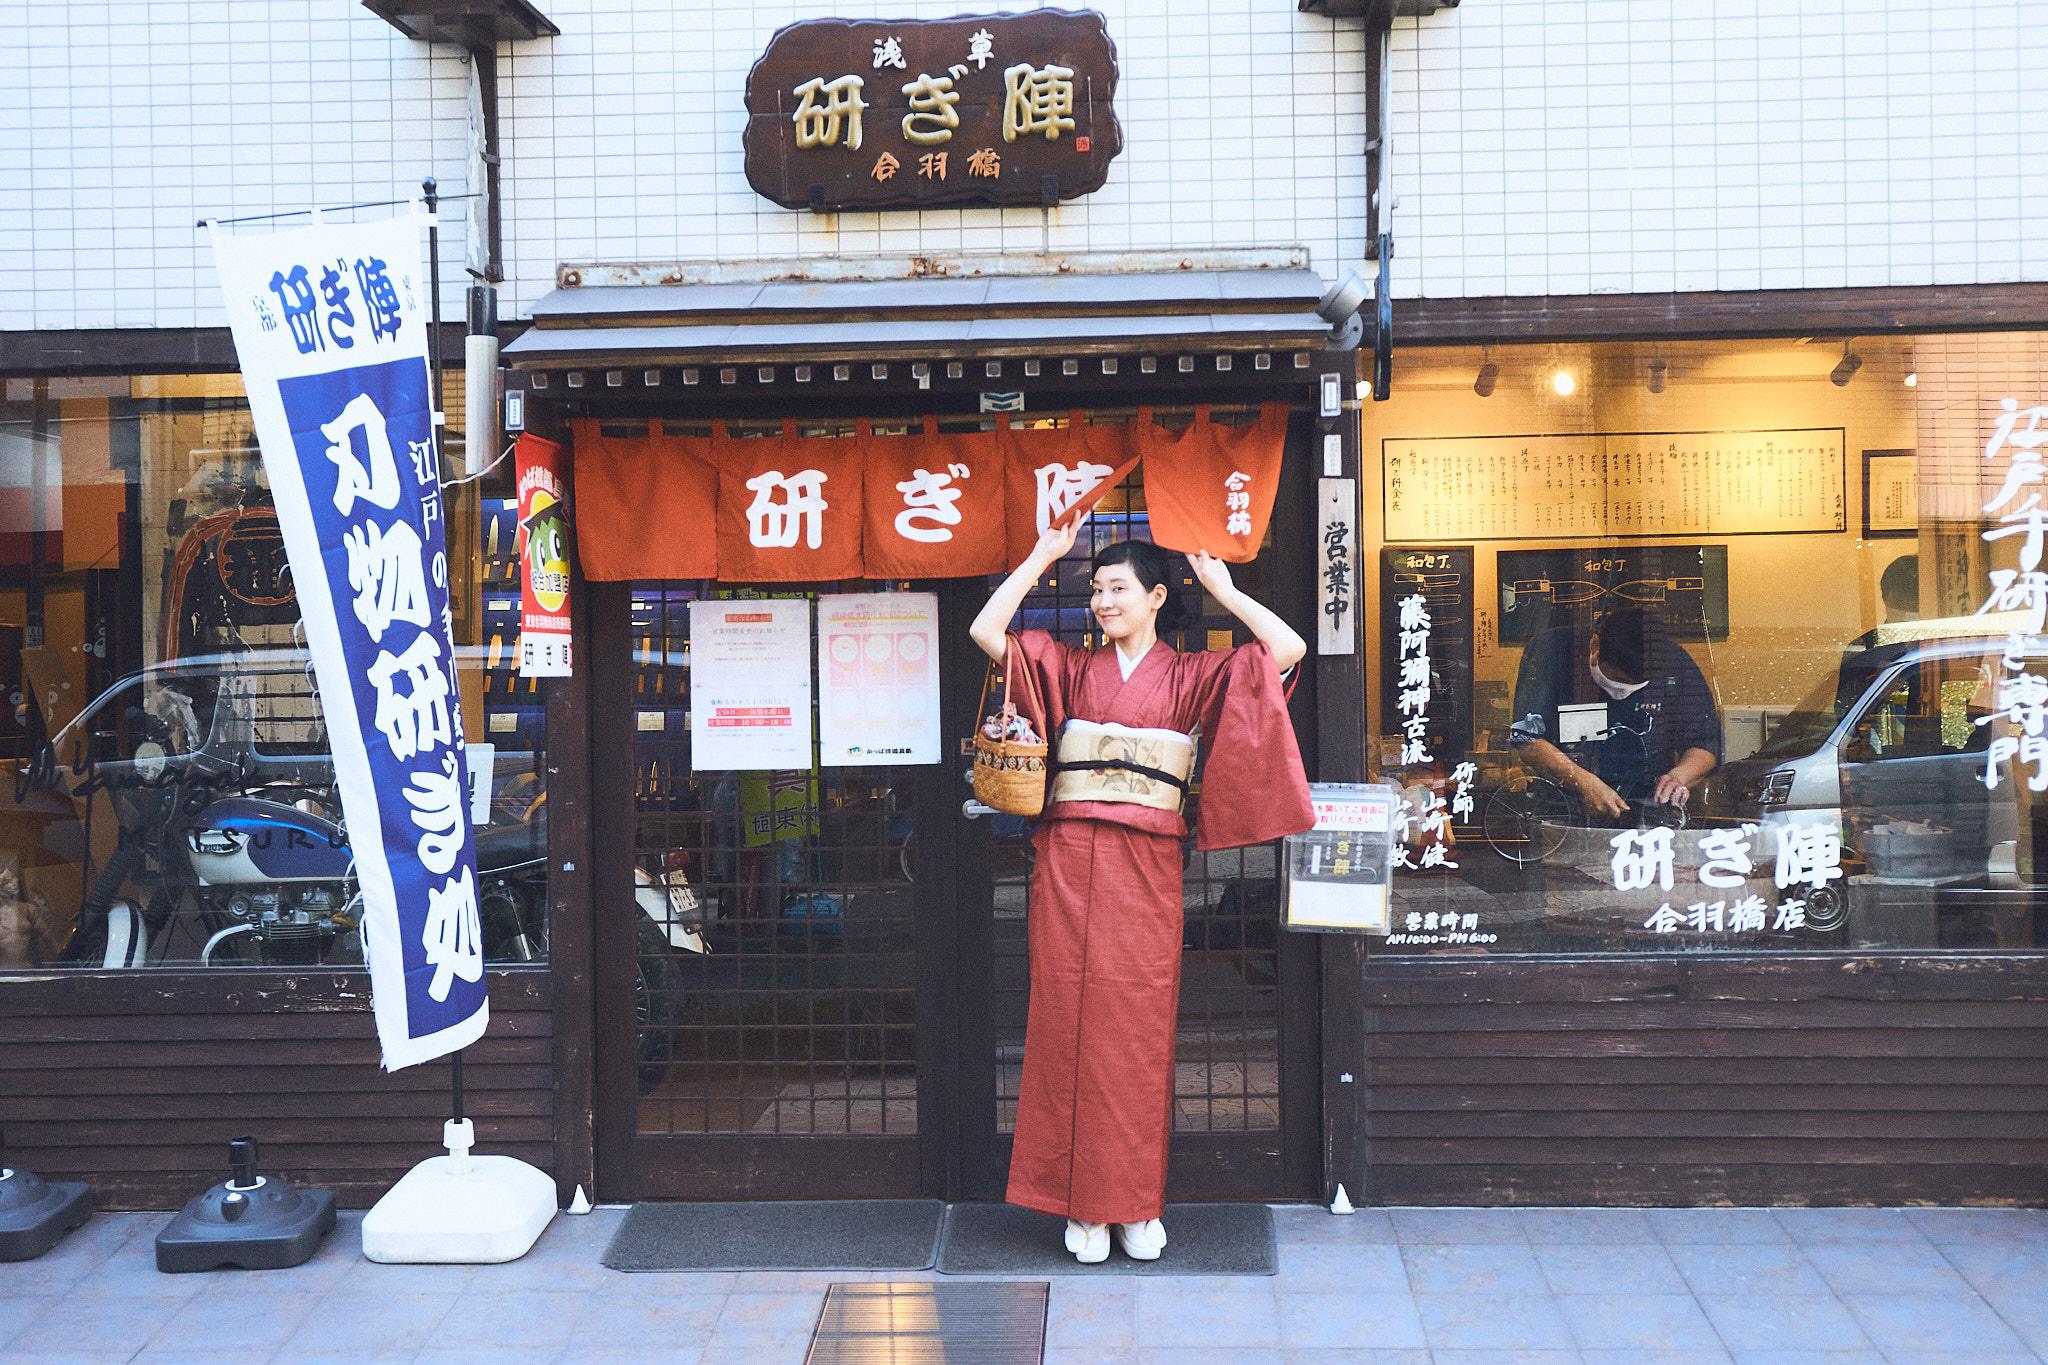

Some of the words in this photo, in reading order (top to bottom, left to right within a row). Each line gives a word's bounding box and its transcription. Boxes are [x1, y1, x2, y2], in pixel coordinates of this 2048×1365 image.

[873, 28, 995, 70] 浅草
[792, 62, 1076, 152] 研ぎ陣
[870, 148, 1002, 183] 合羽橋
[269, 256, 402, 354] 研ぎ陣
[1224, 471, 1251, 536] 合羽橋
[1323, 521, 1351, 631] 営業中
[1609, 822, 1845, 892] 研ぎ陣
[1405, 910, 1479, 932] 営業時間
[1643, 893, 1807, 933] 合羽橋店
